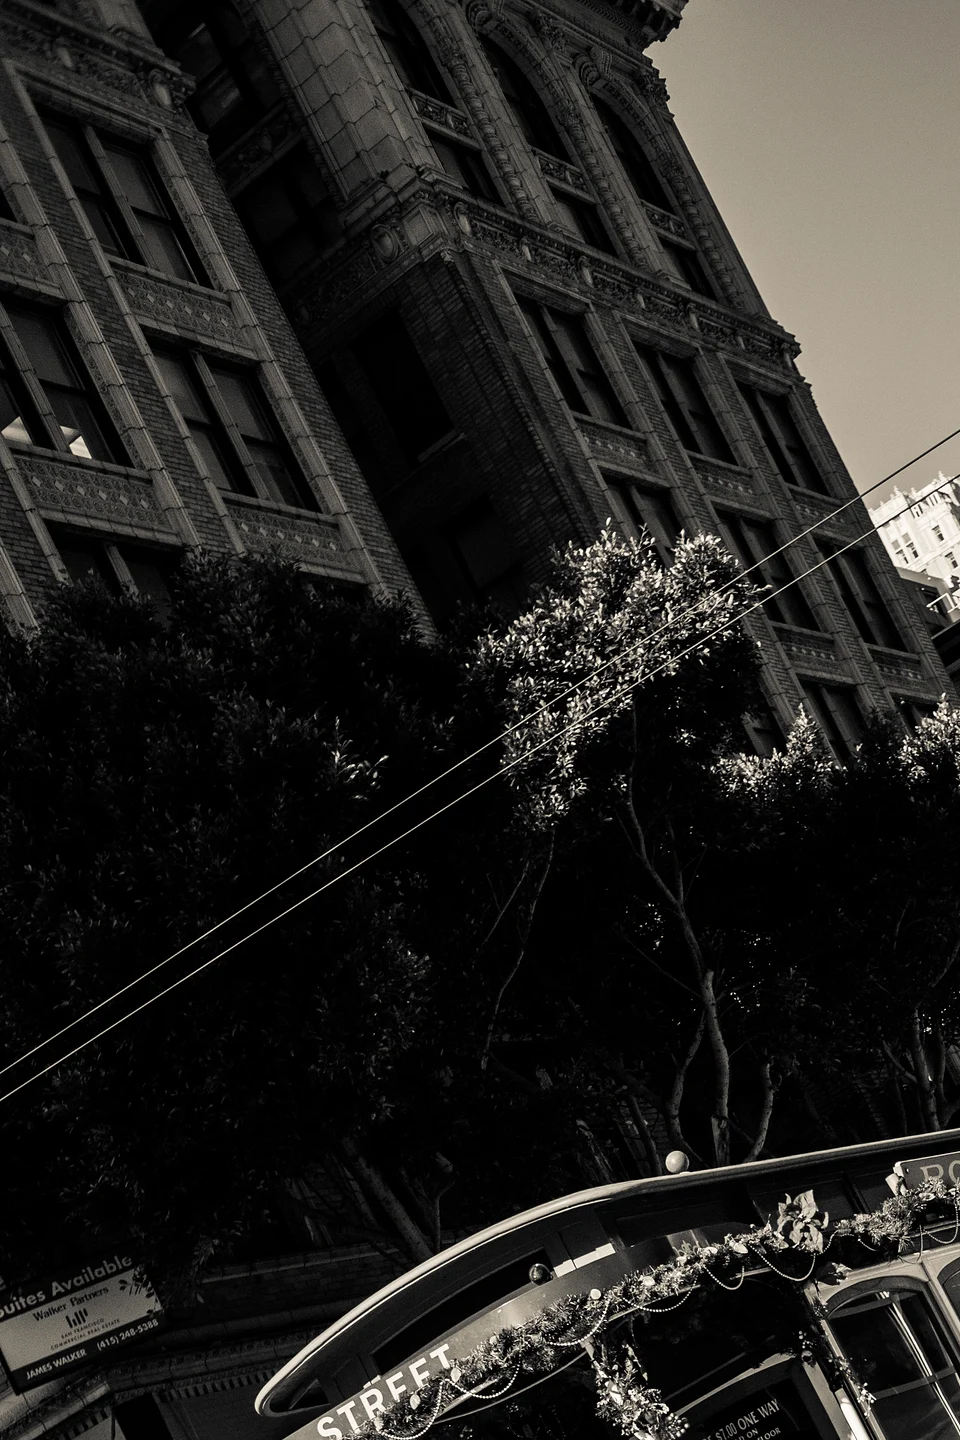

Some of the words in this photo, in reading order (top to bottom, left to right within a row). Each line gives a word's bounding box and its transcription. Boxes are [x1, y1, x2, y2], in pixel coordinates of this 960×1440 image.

[51, 1255, 133, 1297] Available
[32, 1303, 67, 1322] Walker
[69, 1286, 109, 1307] Partners
[26, 1363, 52, 1380] JAMES
[52, 1349, 87, 1368] WALKER
[97, 1336, 120, 1351] (415)
[737, 1411, 759, 1431] ONE
[757, 1399, 781, 1418] WAY
[746, 1428, 759, 1439] ON
